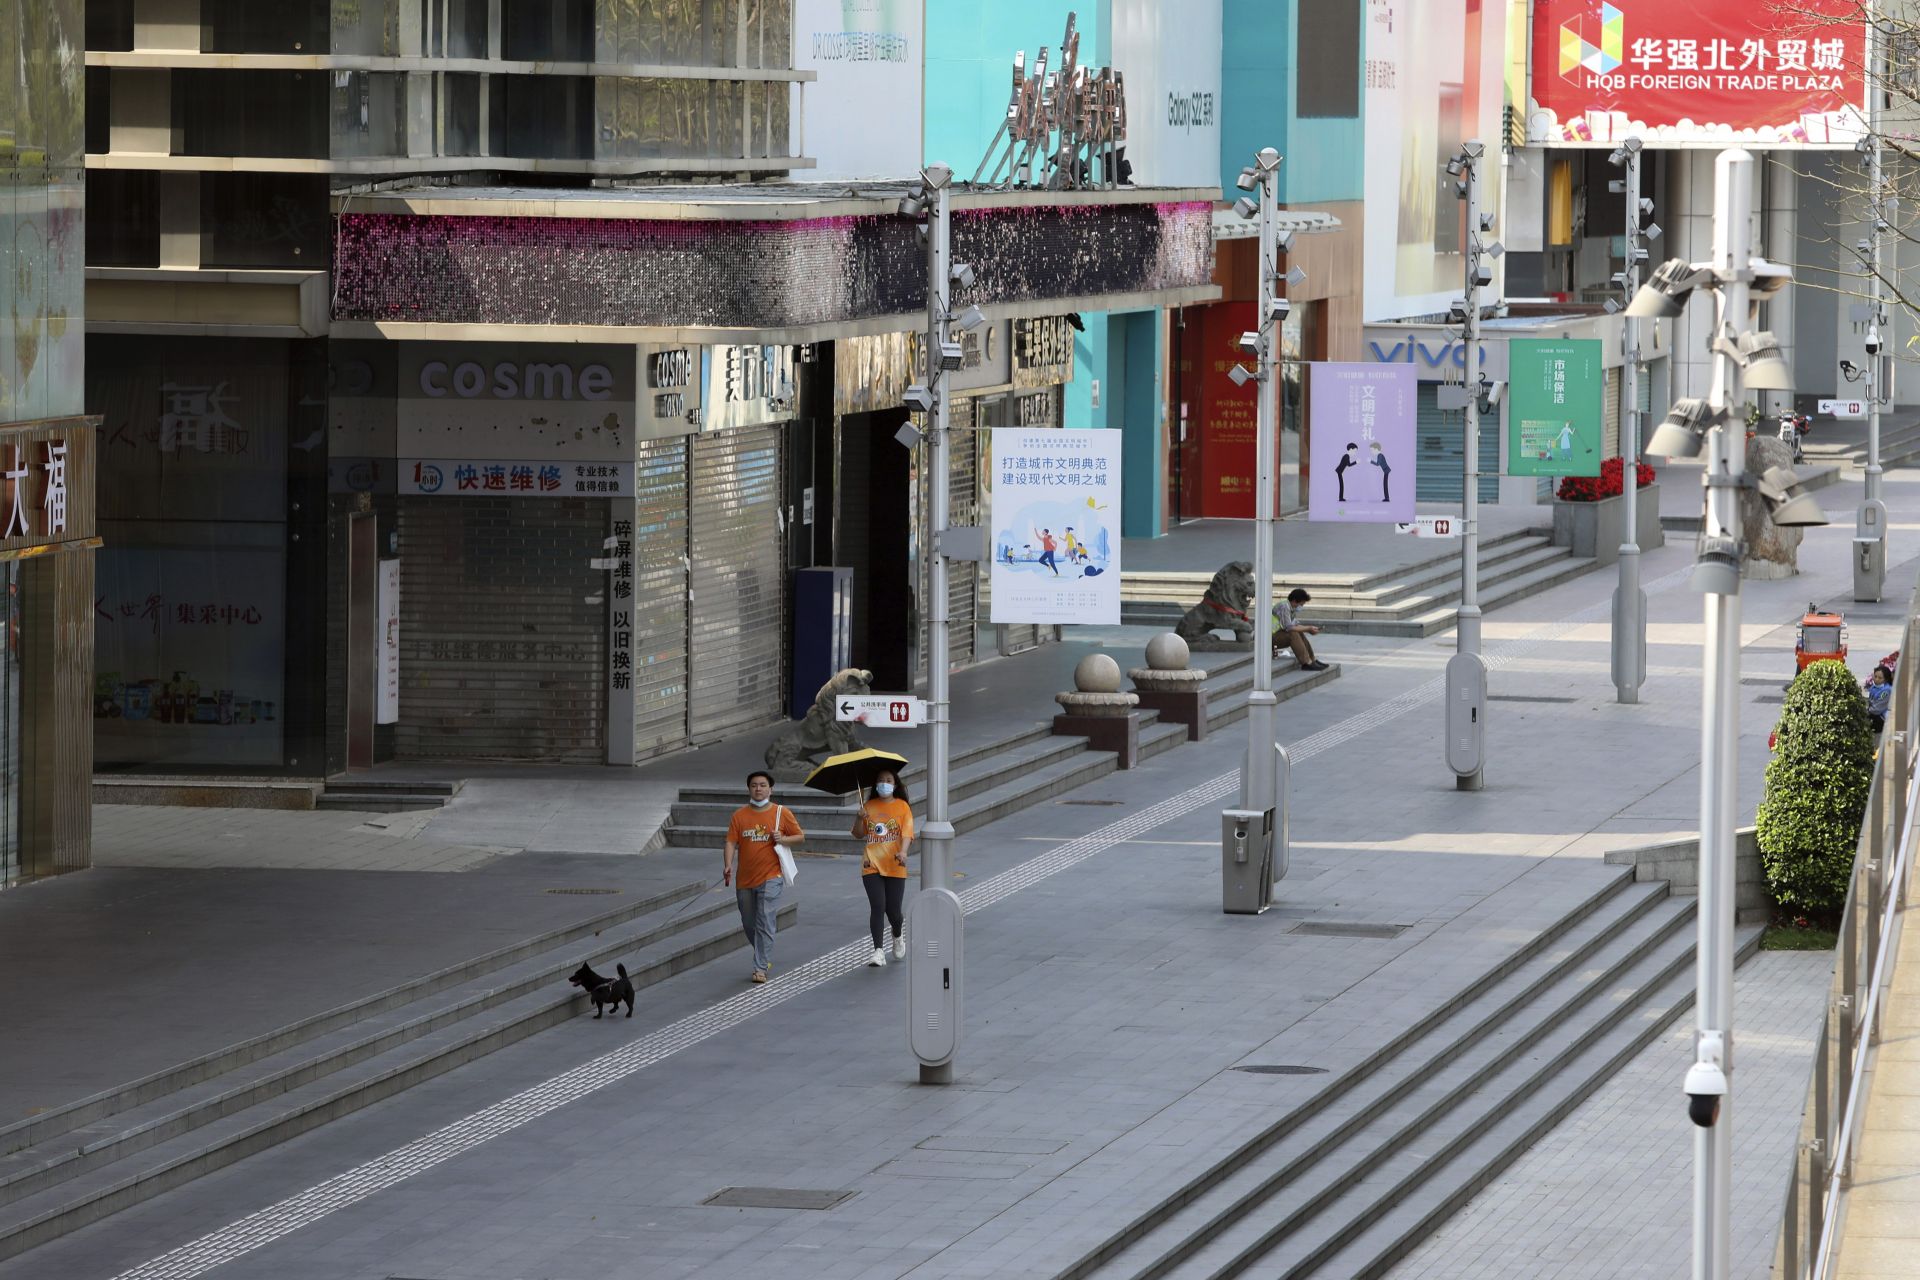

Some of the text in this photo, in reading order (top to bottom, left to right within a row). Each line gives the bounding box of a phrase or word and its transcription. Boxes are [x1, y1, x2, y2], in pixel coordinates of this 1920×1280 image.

[1631, 38, 1845, 71] 华强北外贸城
[1587, 75, 1844, 91] HQB FOREIGN TRADE PLAZA
[1168, 91, 1191, 135] Galaxy
[1192, 91, 1202, 126] S22
[1369, 334, 1486, 369] vivo
[420, 360, 614, 401] cosme
[656, 350, 692, 388] cosme
[1553, 360, 1565, 404] 市场保洁
[663, 394, 684, 418] TOKYO
[1361, 385, 1376, 441] 文明有礼
[454, 464, 562, 491] 快速维修
[575, 465, 619, 477] 专业技术
[1002, 457, 1108, 470] 打造城市文明典范
[1002, 472, 1108, 486] 建设现代文明之城
[5, 434, 67, 540] 大福
[575, 480, 619, 493] 值得信赖
[613, 520, 632, 599] 碎屏维修
[176, 603, 262, 625] 集采中心
[612, 610, 631, 691] 以旧换新
